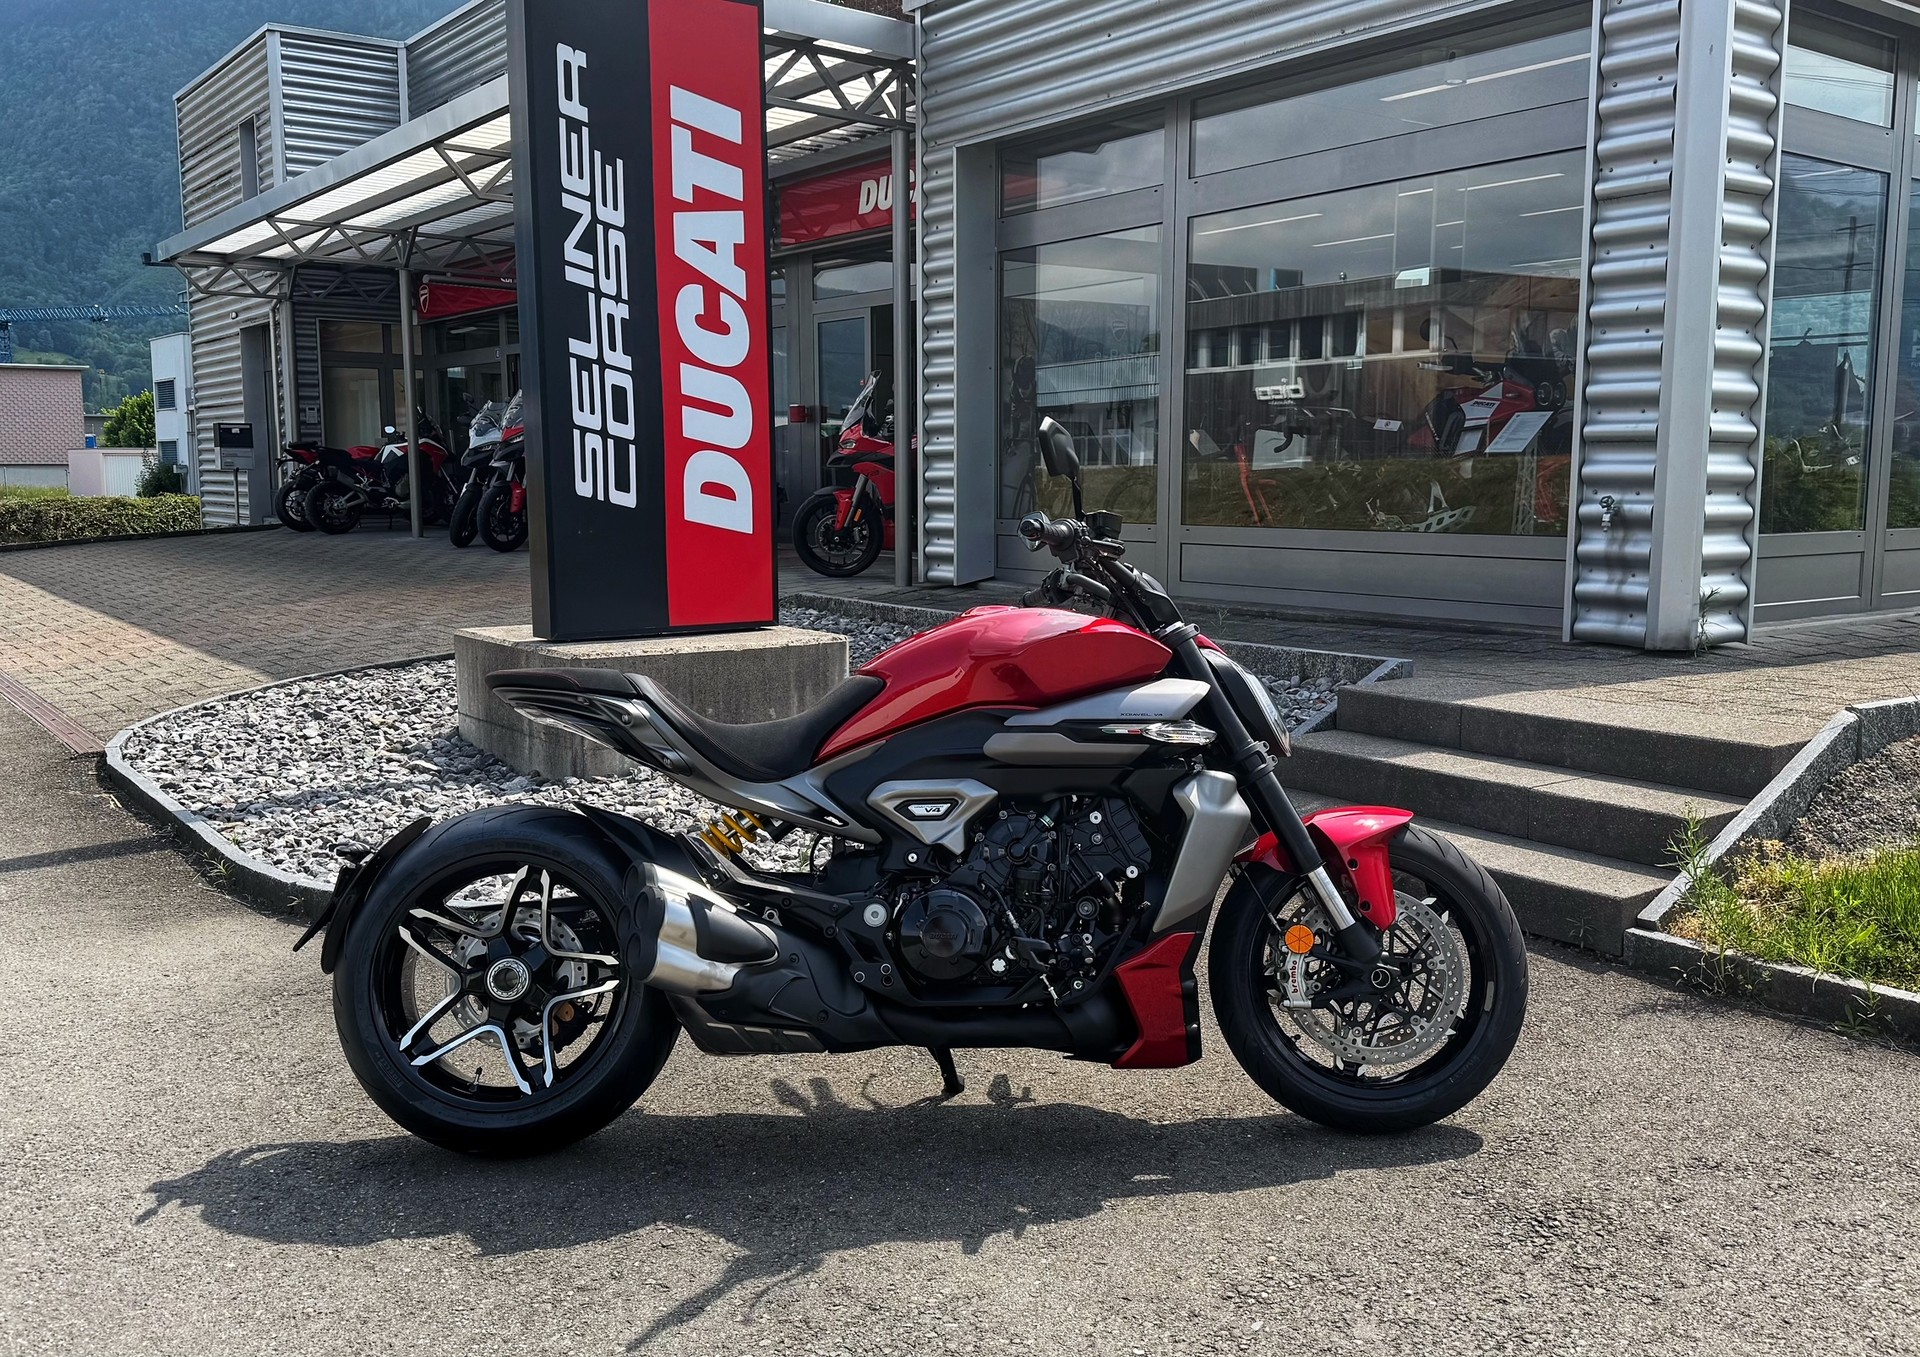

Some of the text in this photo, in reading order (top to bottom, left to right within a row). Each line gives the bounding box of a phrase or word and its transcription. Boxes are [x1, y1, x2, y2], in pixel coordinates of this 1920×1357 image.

[556, 42, 605, 501] SELINER
[594, 149, 637, 509] CORSE
[669, 84, 753, 535] DUCATI
[1290, 960, 1298, 994] brembo
